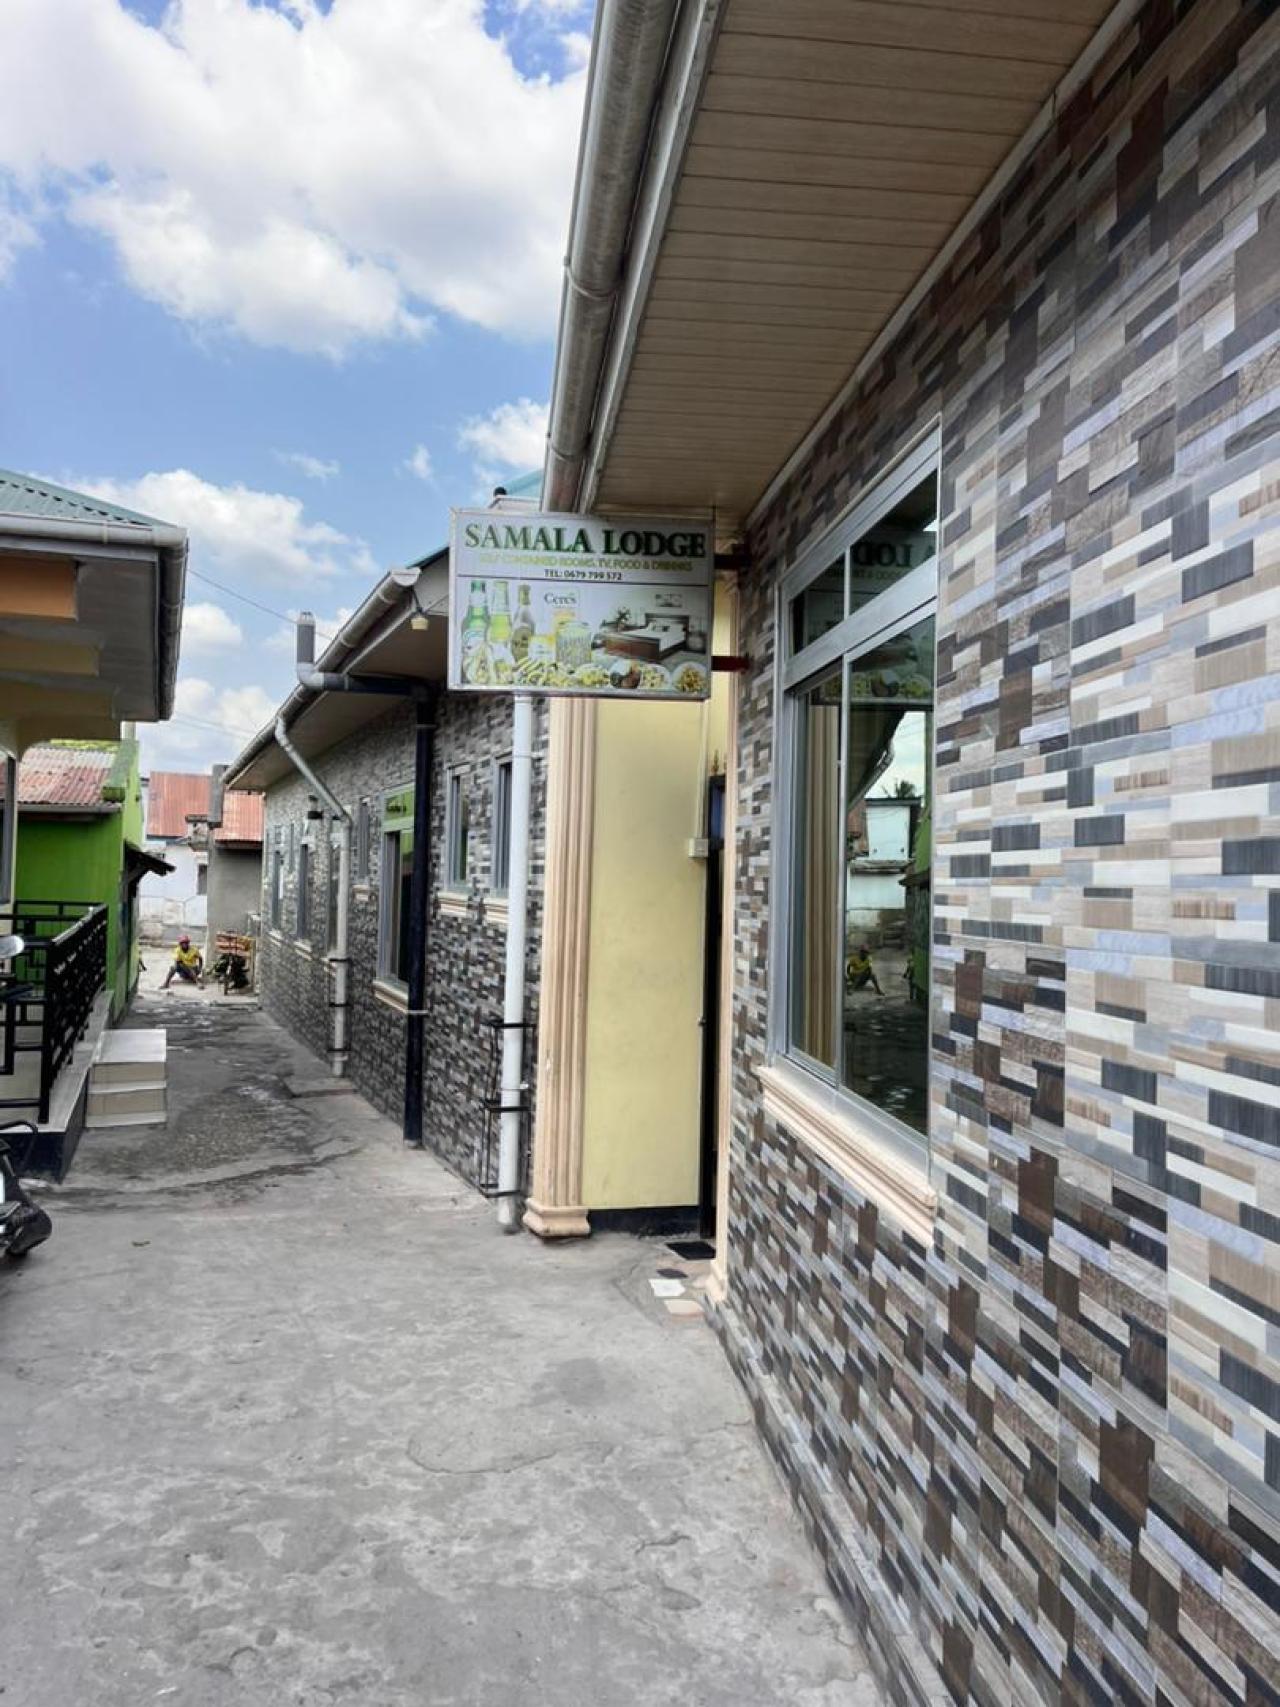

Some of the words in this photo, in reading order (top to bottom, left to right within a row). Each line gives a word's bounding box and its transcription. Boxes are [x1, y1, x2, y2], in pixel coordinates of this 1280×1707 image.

[464, 523, 596, 553] SAMALA
[602, 529, 705, 557] LODGE
[544, 568, 562, 578] TEL:
[564, 569, 586, 580] 0679
[606, 572, 622, 581] 572
